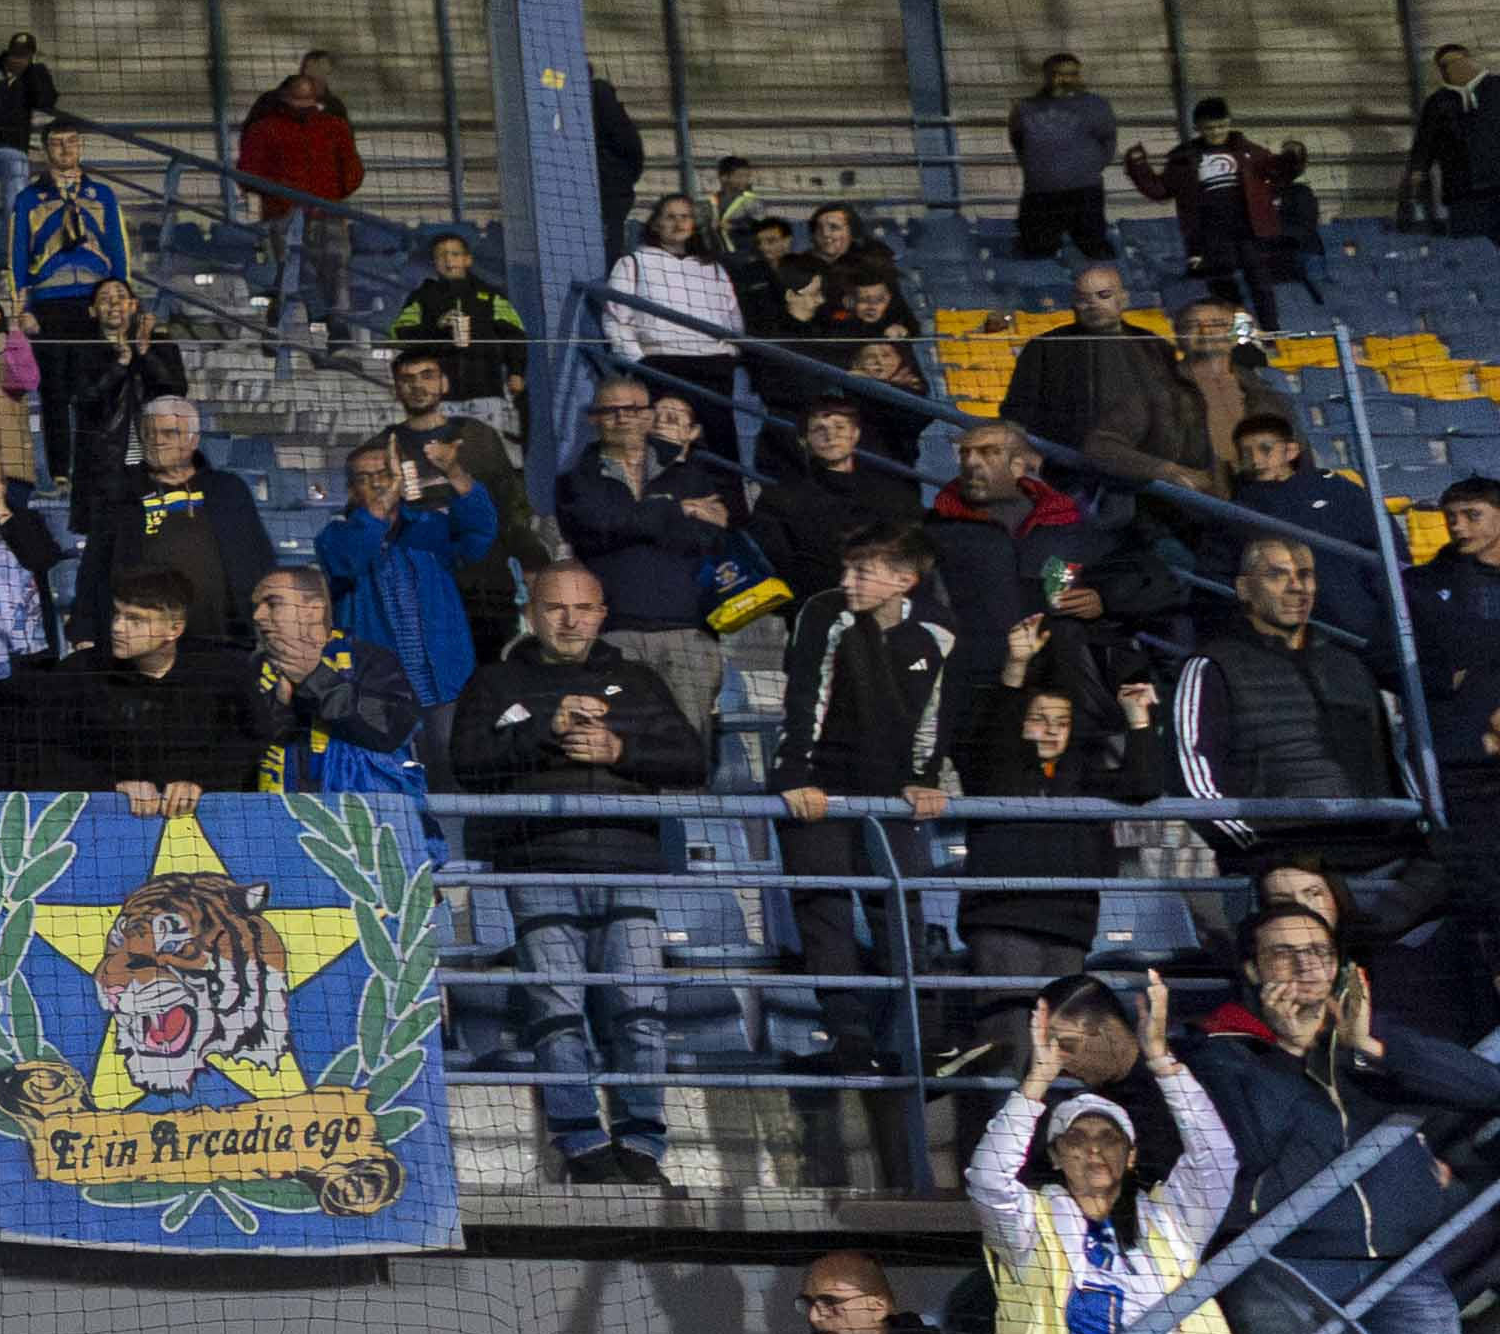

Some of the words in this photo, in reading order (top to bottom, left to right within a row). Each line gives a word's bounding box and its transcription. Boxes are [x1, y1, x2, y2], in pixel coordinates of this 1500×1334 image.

[49, 1129, 92, 1171] Et
[103, 1136, 138, 1167] in
[150, 1114, 294, 1165] Arcadia
[303, 1117, 362, 1158] ego
